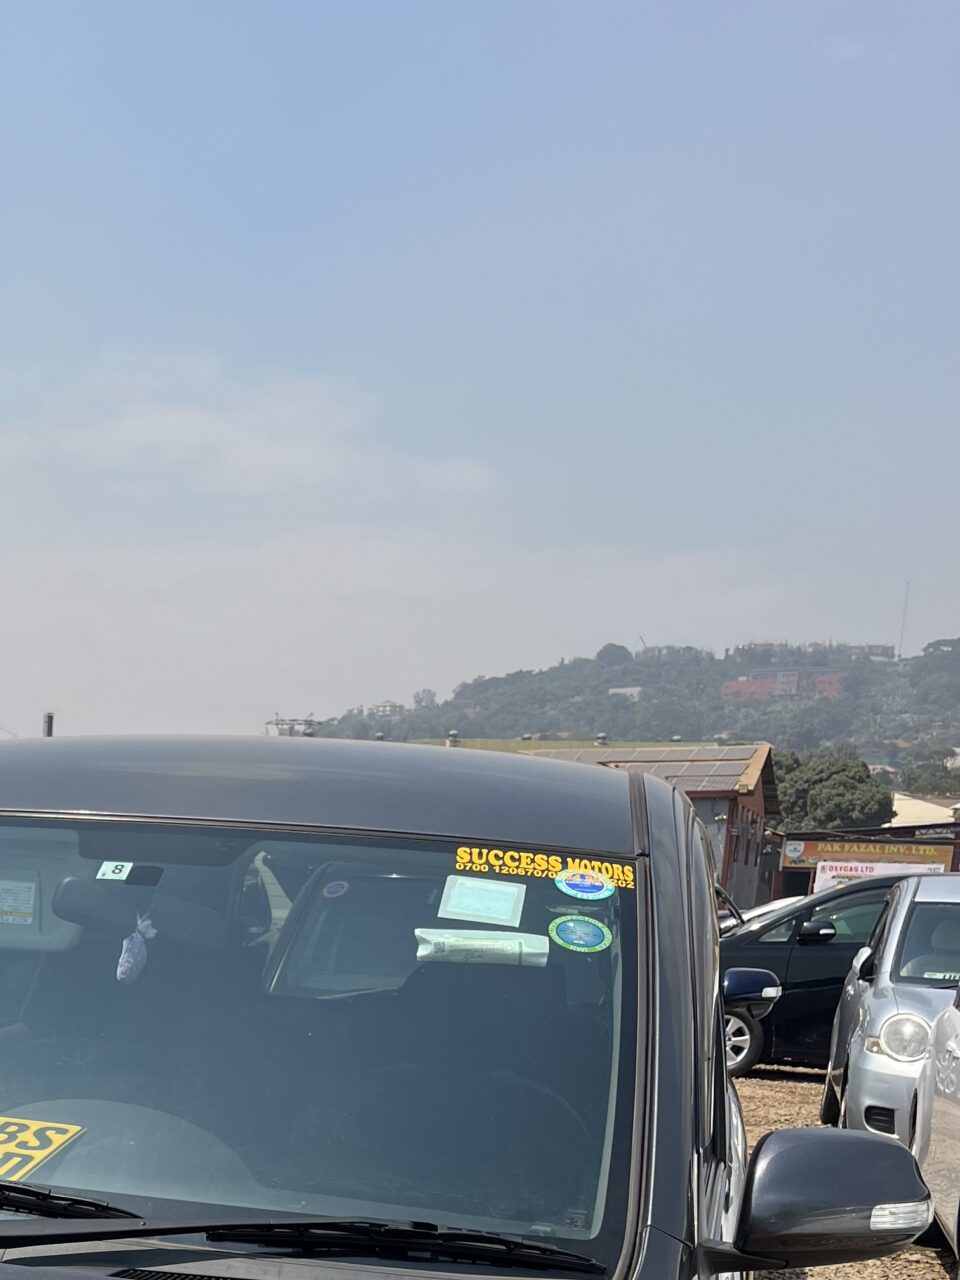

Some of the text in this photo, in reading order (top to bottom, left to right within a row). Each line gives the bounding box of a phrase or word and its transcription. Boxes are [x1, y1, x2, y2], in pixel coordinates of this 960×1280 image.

[818, 842, 840, 853] PAK
[112, 864, 125, 875] 8
[456, 847, 634, 881] SUCCESS MOTORS
[456, 862, 489, 872] 0700
